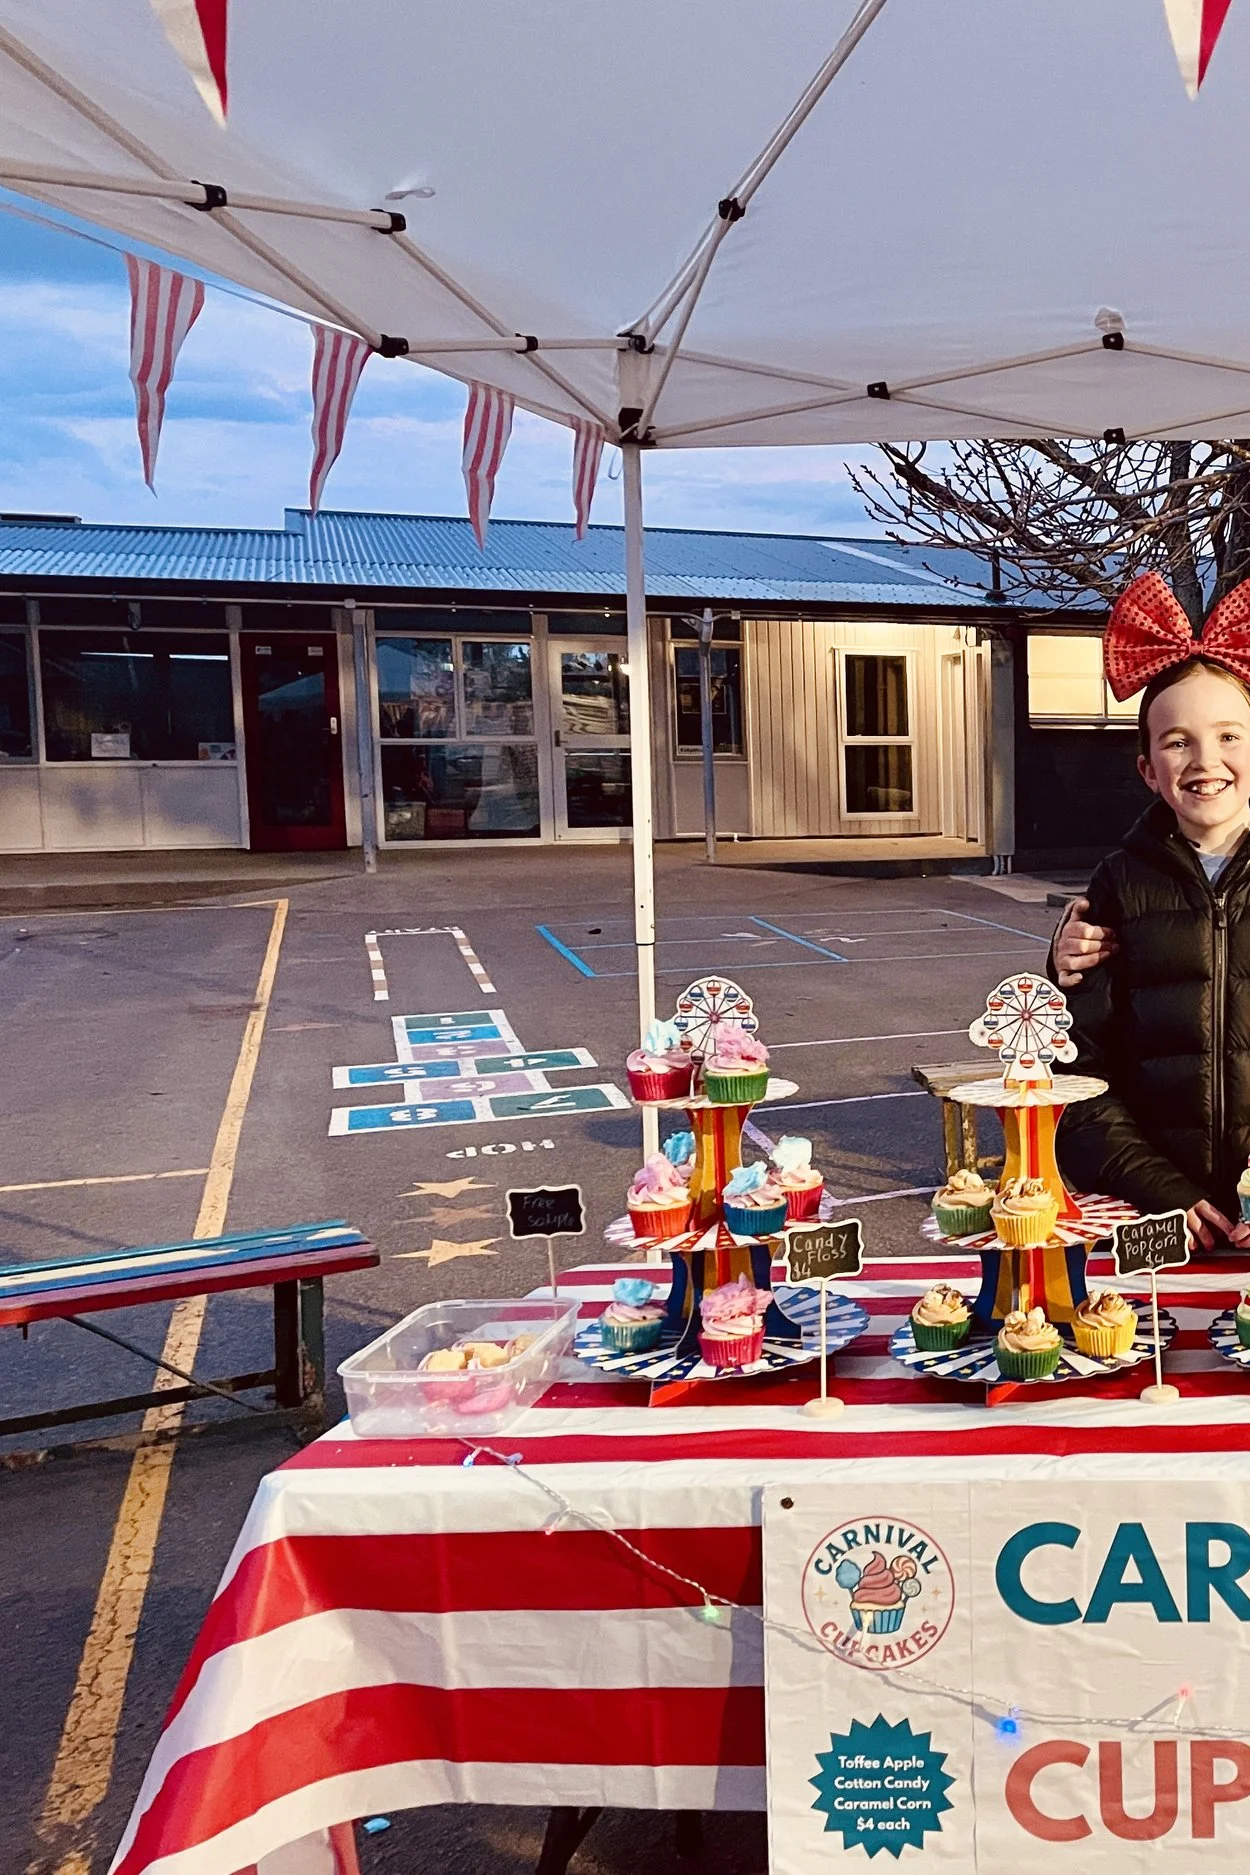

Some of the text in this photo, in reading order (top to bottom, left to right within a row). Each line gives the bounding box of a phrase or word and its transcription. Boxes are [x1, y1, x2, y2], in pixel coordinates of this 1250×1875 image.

[433, 1029, 472, 1040] 2
[503, 1058, 547, 1068] 4
[383, 1066, 427, 1077] 5
[530, 1094, 577, 1110] 7
[389, 1107, 439, 1122] 8
[446, 1139, 556, 1159] HOP
[523, 1195, 556, 1210] Free
[793, 1232, 848, 1253] Candy
[807, 1248, 847, 1265] Floss
[1145, 1251, 1165, 1268] $4
[791, 1261, 811, 1280] $4
[814, 1523, 939, 1576] CARNIVAL
[837, 1755, 925, 1771] Toffee Apple
[833, 1775, 930, 1792] Cotton Candy
[833, 1796, 932, 1810] Caramel Corn
[856, 1816, 911, 1832] $4 each
